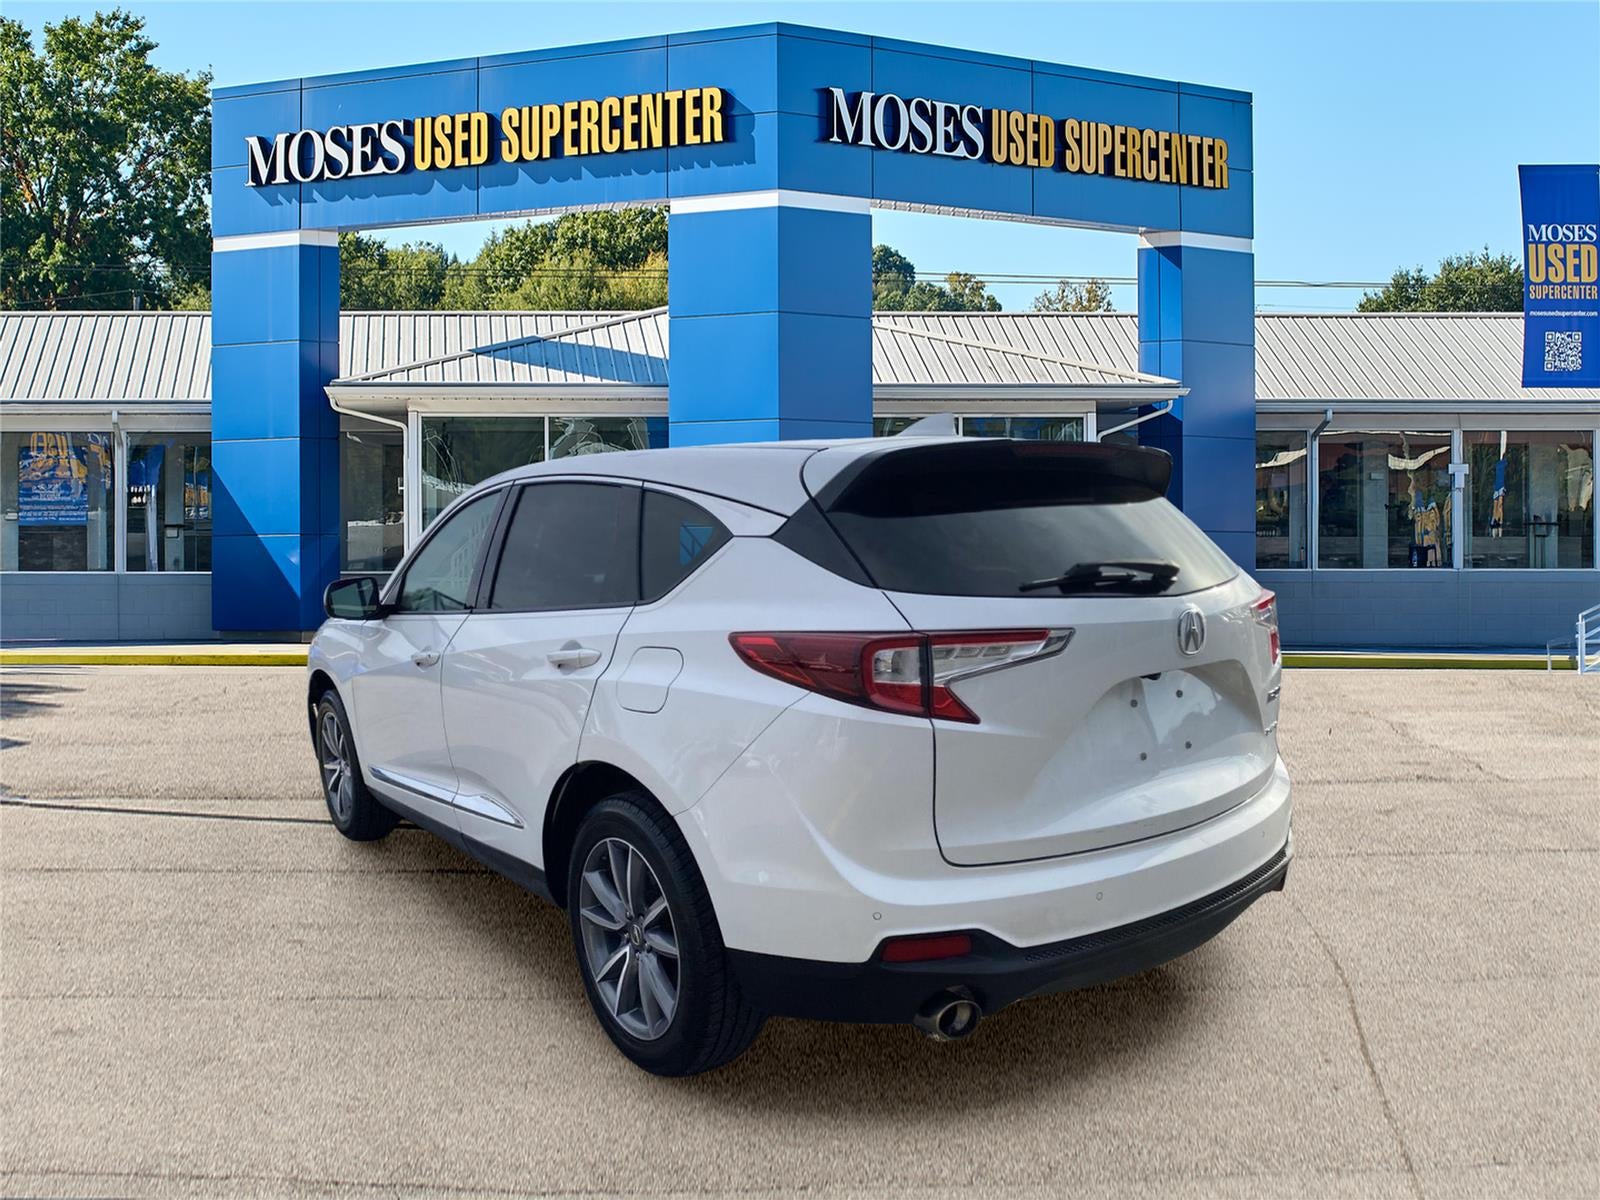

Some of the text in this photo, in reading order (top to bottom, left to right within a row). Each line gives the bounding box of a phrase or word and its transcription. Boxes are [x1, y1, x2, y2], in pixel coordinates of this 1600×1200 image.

[244, 86, 725, 188] MOSES USED SUPERCENTER
[827, 86, 1229, 189] MOSES USED SUPERCENTER
[1528, 224, 1597, 242] MOSES
[1529, 244, 1598, 283] USED
[1529, 285, 1598, 300] SUPERCENTER
